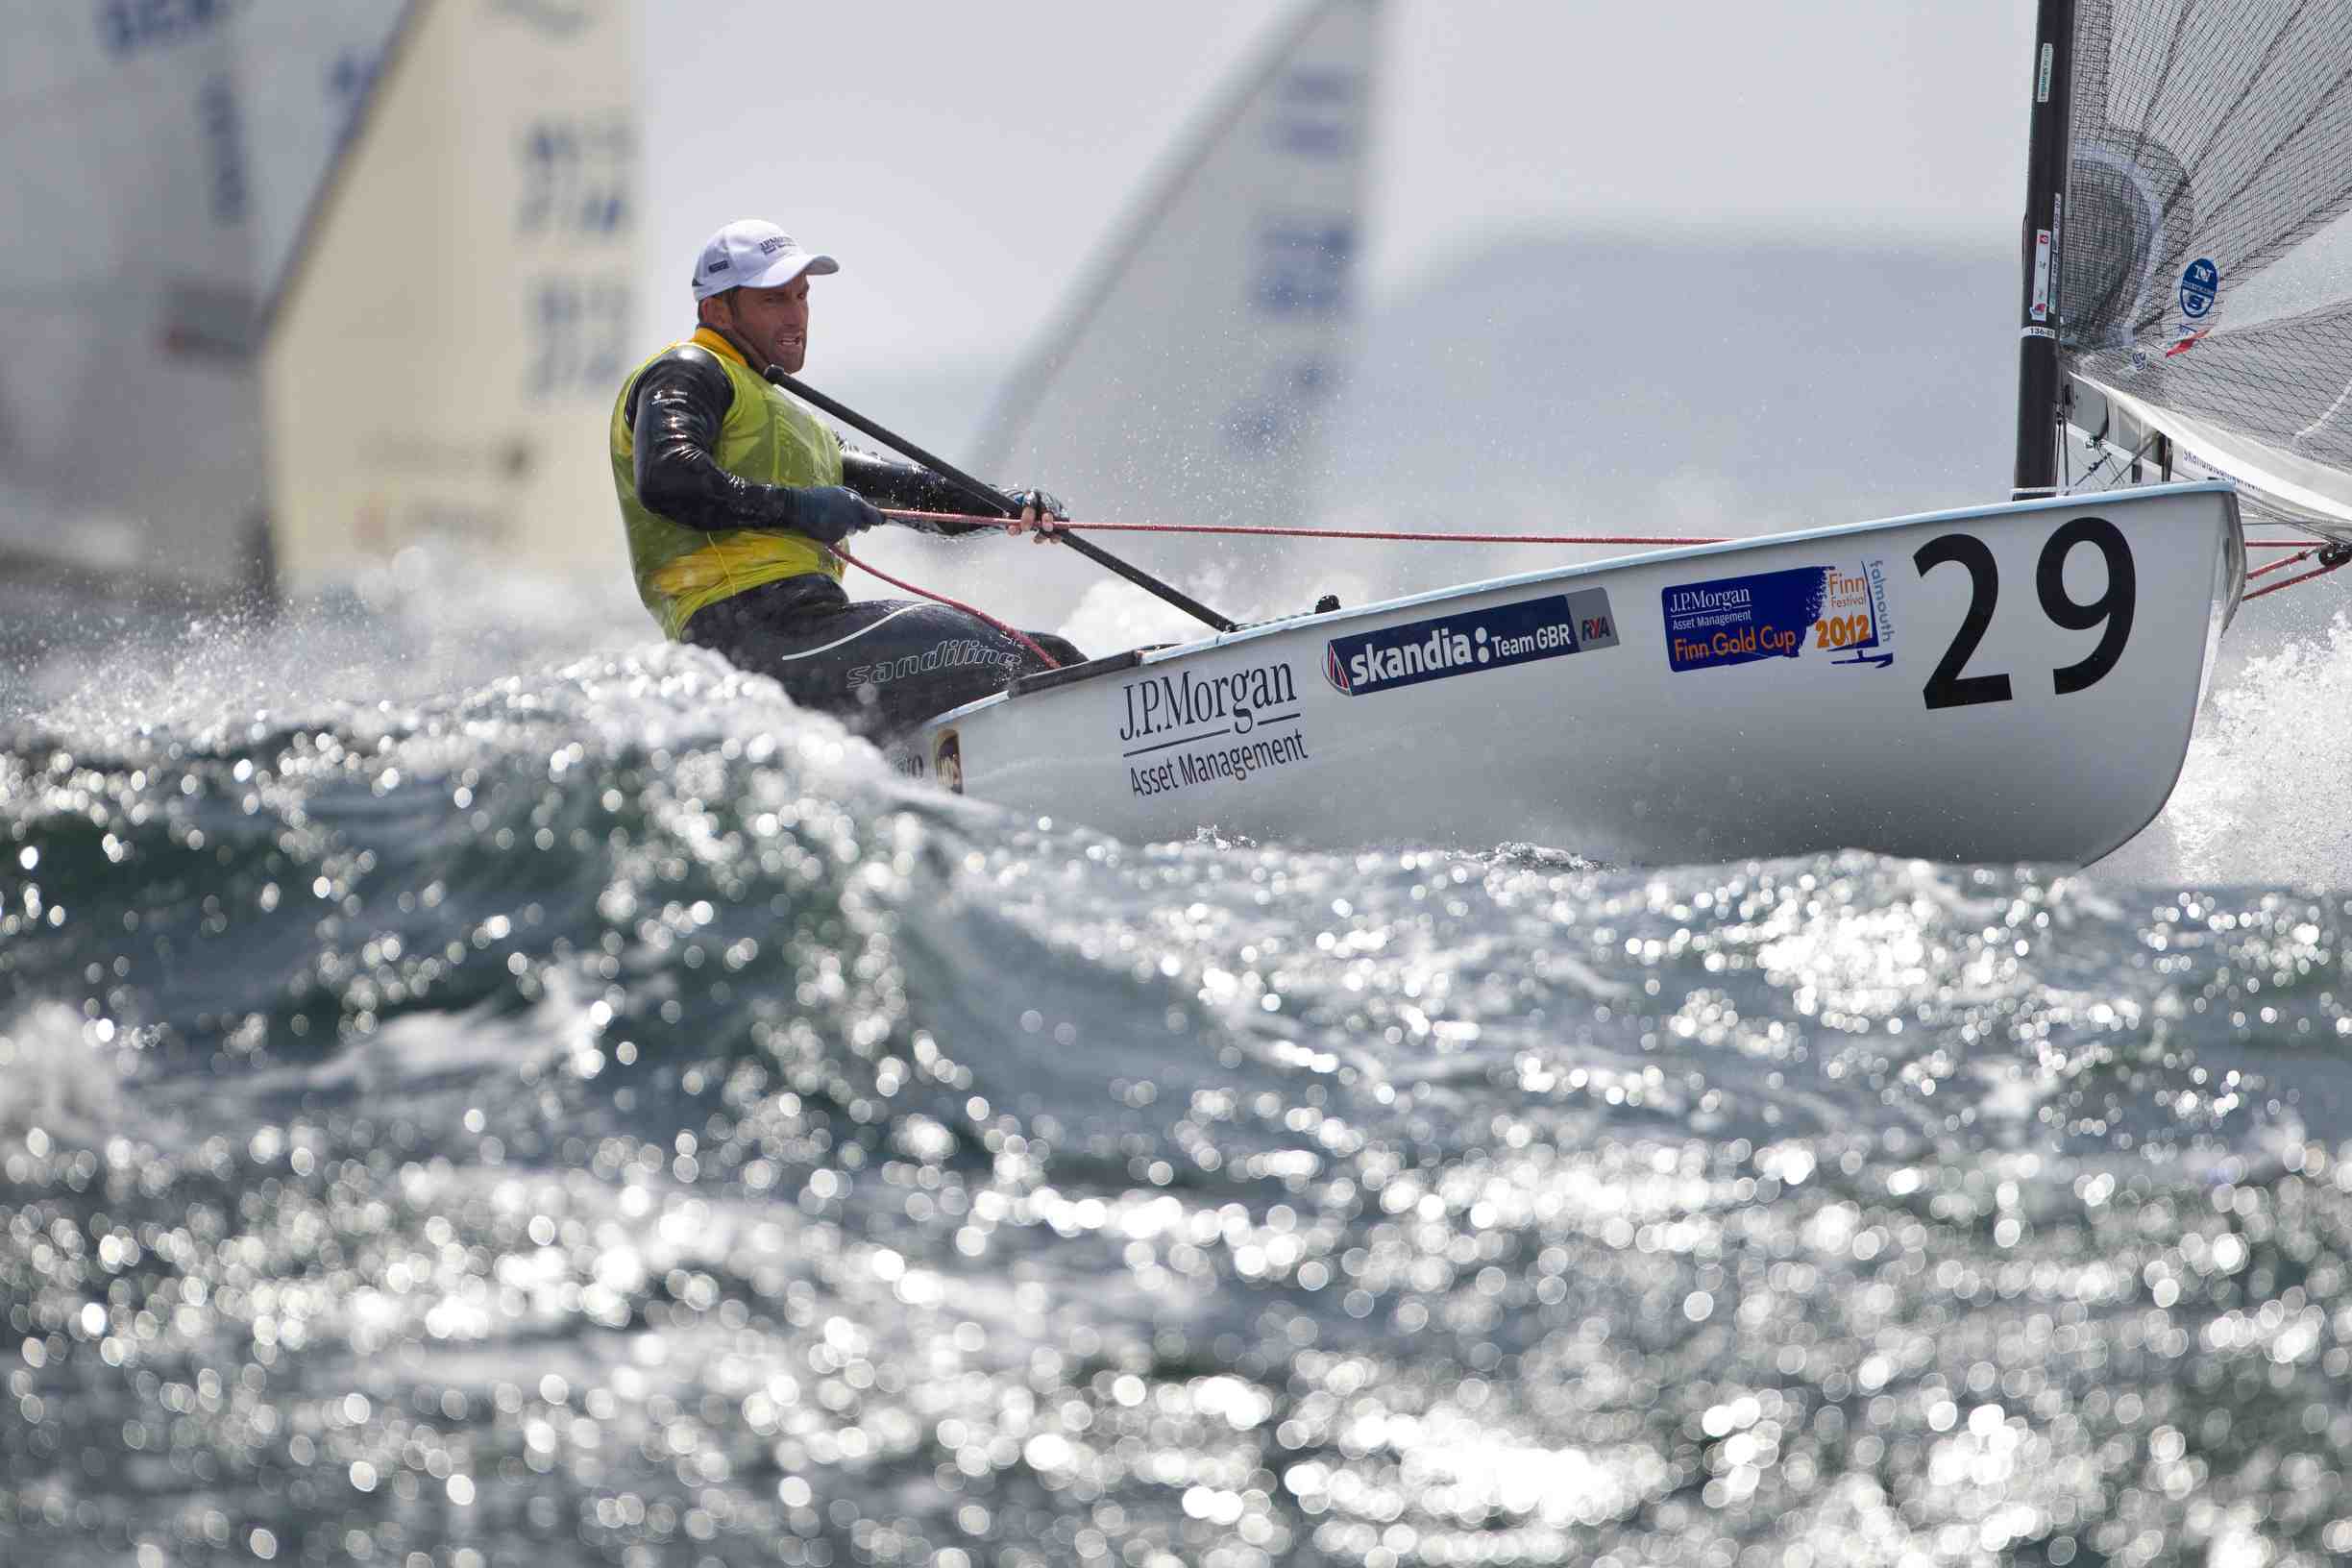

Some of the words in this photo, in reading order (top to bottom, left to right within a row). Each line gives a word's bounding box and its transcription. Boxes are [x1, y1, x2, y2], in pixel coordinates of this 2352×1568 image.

[1670, 587, 1751, 612] J.P.Morgan
[1828, 573, 1865, 595] Finn
[1830, 594, 1866, 608] Festival
[1870, 560, 1895, 643] falmouth
[1581, 616, 1611, 642] RYA
[1673, 618, 1696, 630] Asset
[1697, 609, 1752, 626] Management
[1913, 516, 2136, 709] 29
[1491, 634, 1534, 658] Team
[1536, 624, 1571, 649] GBR
[1675, 637, 1709, 661] Finn
[1712, 626, 1756, 655] Gold
[1760, 625, 1796, 654] Cup
[1815, 613, 1871, 649] 2012
[1119, 662, 1297, 741] J.P.Morgan
[1130, 757, 1179, 797] Asset
[1179, 728, 1309, 786] Management
